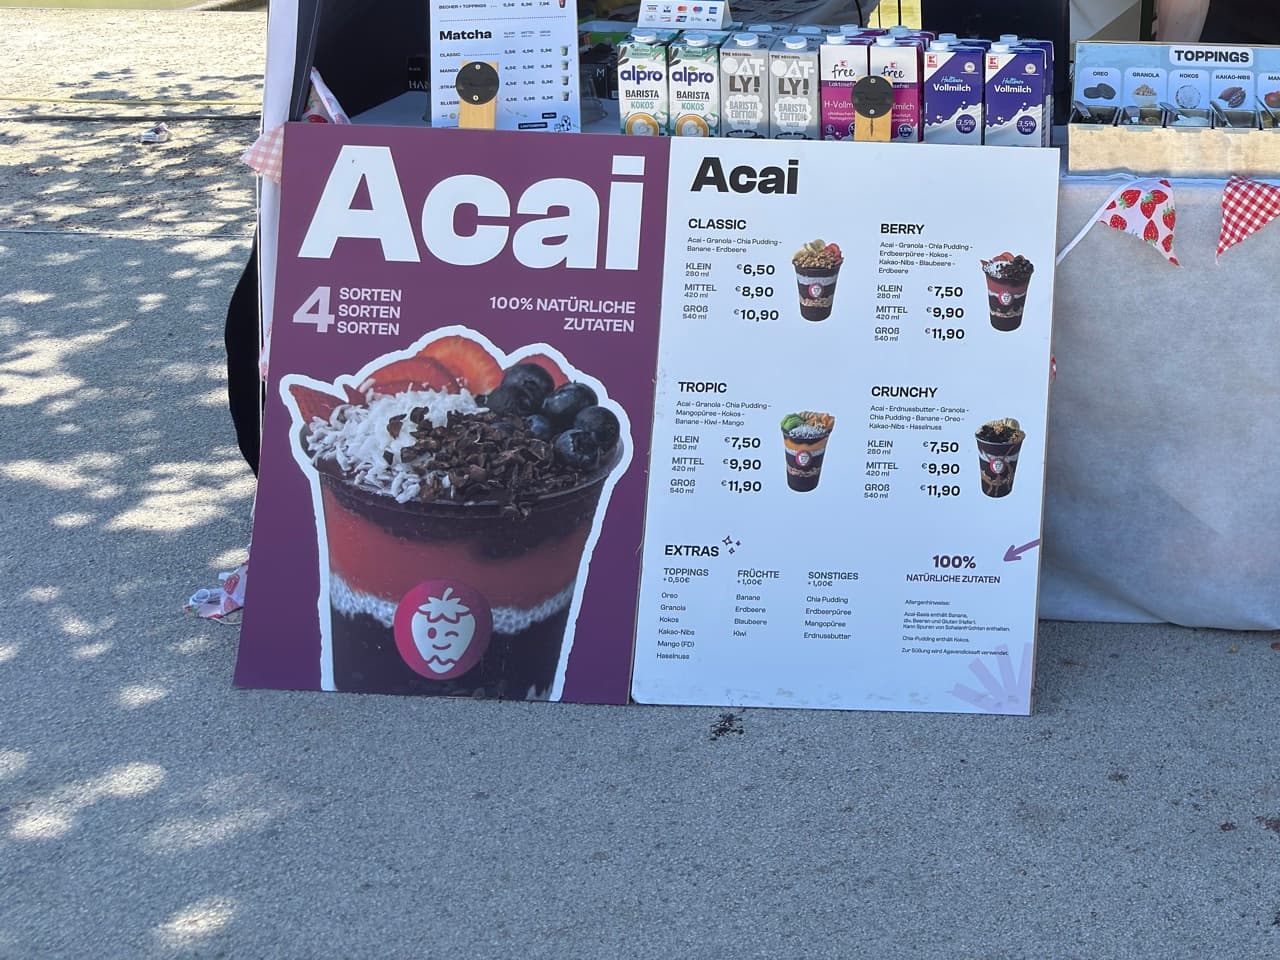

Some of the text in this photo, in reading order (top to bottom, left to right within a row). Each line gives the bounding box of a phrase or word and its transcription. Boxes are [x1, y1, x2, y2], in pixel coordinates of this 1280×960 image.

[440, 30, 492, 40] Matcha
[1175, 50, 1250, 63] TOPPINGS
[722, 58, 765, 76] OAT-
[771, 60, 814, 78] OAT-
[832, 64, 855, 79] free
[620, 65, 663, 85] alpro
[672, 66, 714, 86] alpro
[729, 76, 760, 93] LY!
[779, 78, 809, 95] LY!
[933, 84, 971, 92] Vollmilch
[994, 85, 1031, 93] Vollmilch
[625, 90, 659, 98] BARISTA
[676, 91, 710, 100] BARISTA
[682, 102, 704, 110] KOKOS
[730, 101, 758, 109] BARISTA
[779, 103, 807, 112] BARISTA
[690, 156, 800, 195] Acai
[297, 144, 646, 271] Acai
[688, 218, 747, 230] CLASSIC
[880, 224, 925, 234] BERRY
[684, 284, 717, 292] MITTEL
[339, 287, 402, 302] SORTEN
[292, 286, 335, 333] 4
[489, 295, 636, 315] 100% NATÜRLICHE
[338, 304, 401, 319] SORTEN
[337, 320, 400, 336] SORTEN
[563, 317, 635, 332] ZUTATEN
[678, 382, 727, 393] TROPIC
[872, 386, 938, 398] CRUNCHY
[672, 457, 704, 465] MITTEL
[665, 545, 719, 557] EXTRAS
[932, 555, 976, 568] 100%
[664, 568, 709, 576] TOPPINGS
[737, 569, 780, 579] FRÜCHTE
[808, 572, 859, 580] SONSTIGES
[906, 573, 1000, 583] NATÜRLICHE ZUTATEN
[805, 608, 852, 616] Erdbeerpüree
[805, 620, 846, 628] Mangopüree
[804, 632, 851, 640] Erdnussbutter
